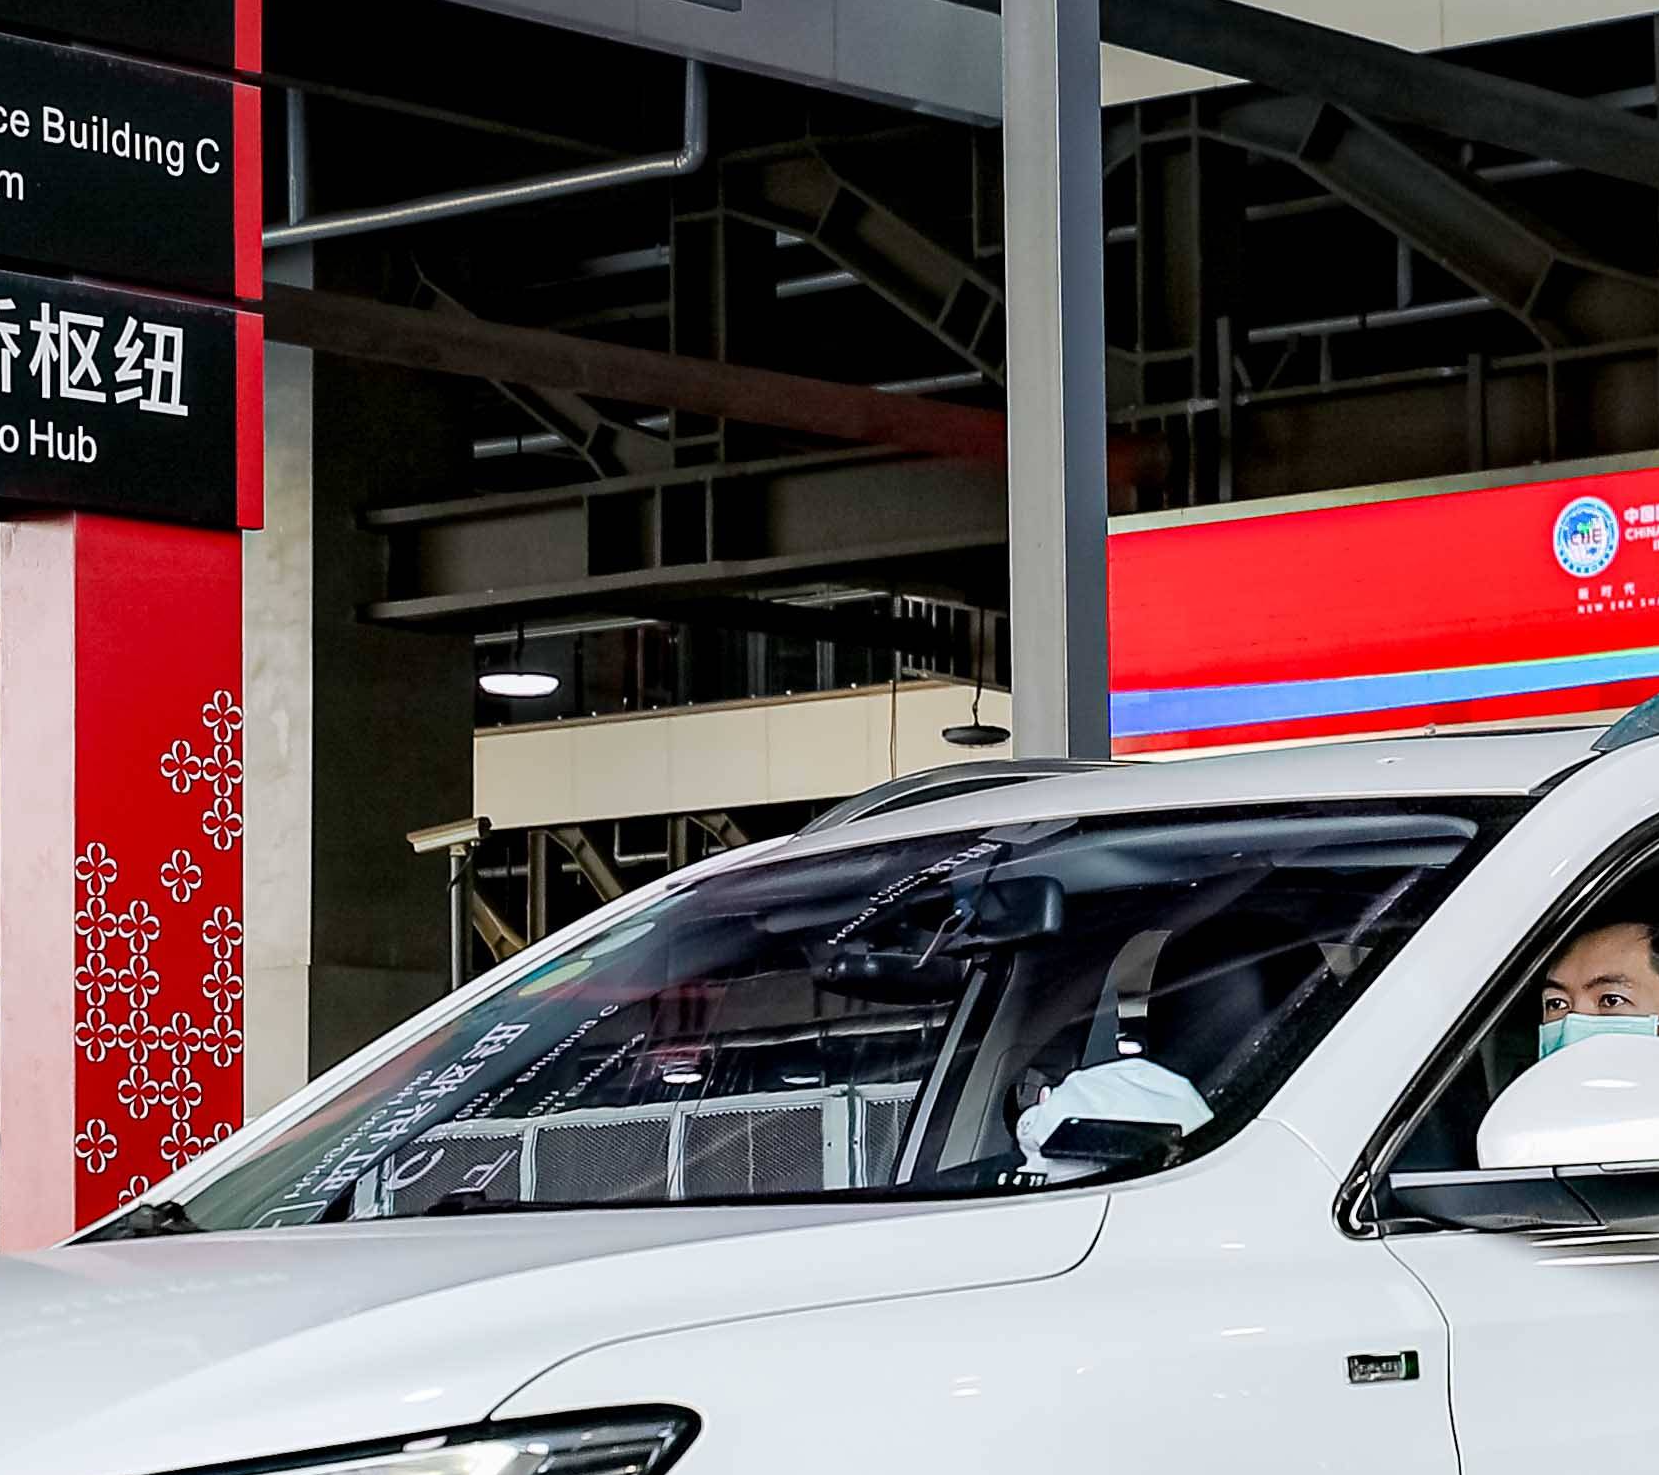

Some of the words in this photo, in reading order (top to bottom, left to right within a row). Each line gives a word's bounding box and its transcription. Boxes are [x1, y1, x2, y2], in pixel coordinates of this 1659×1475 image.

[42, 105, 185, 177] Building
[196, 137, 220, 174] C
[29, 418, 98, 463] Hub
